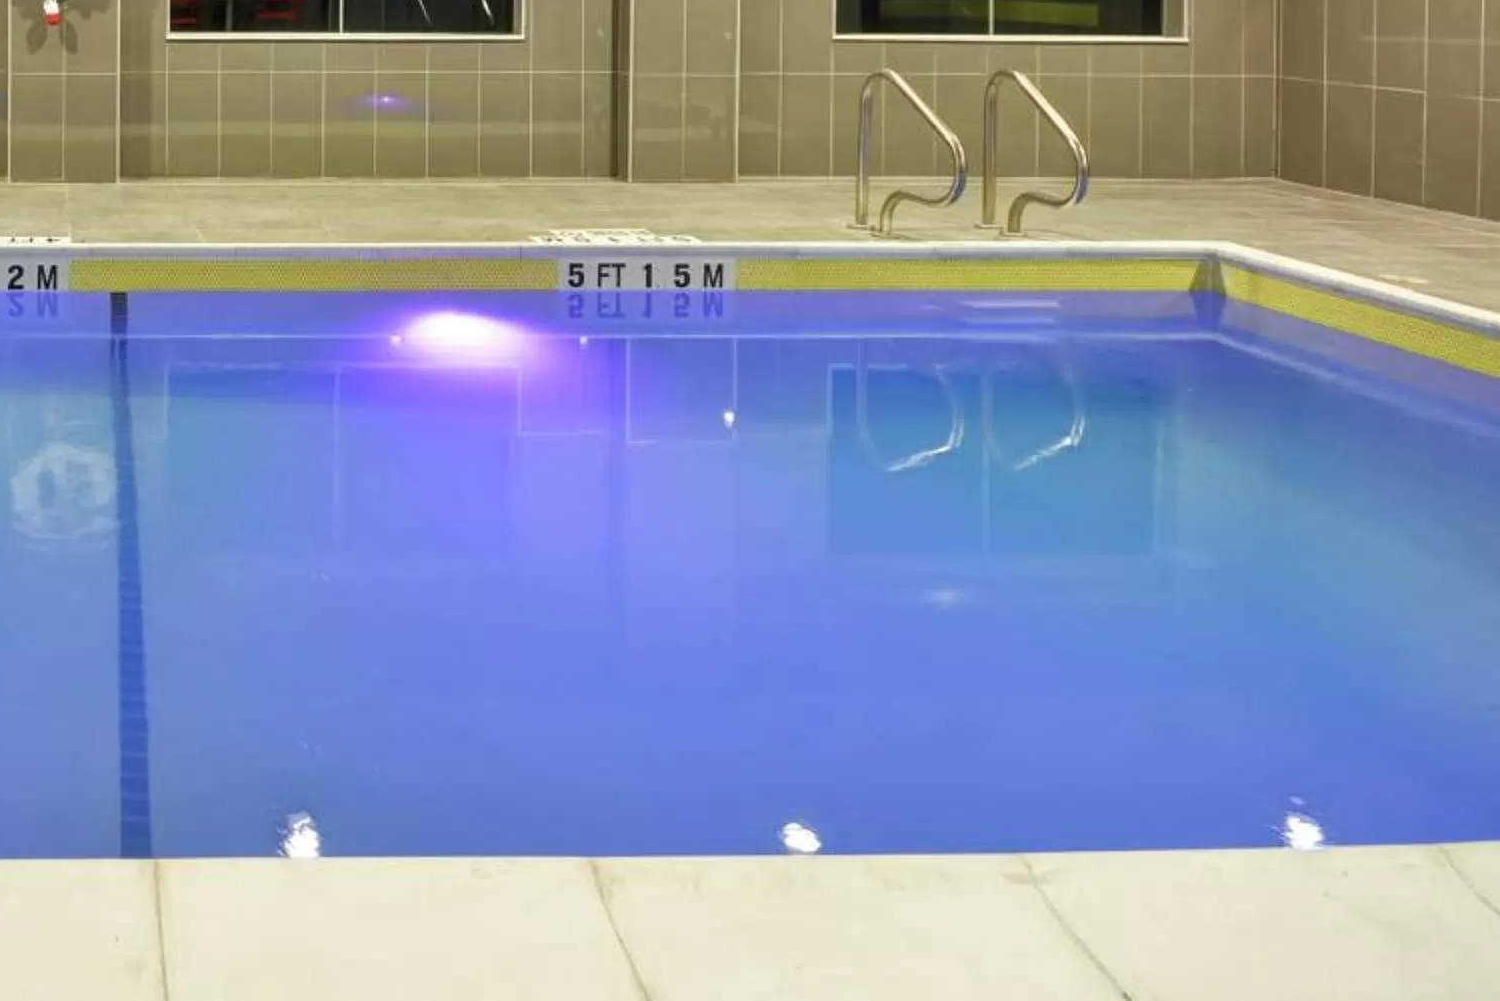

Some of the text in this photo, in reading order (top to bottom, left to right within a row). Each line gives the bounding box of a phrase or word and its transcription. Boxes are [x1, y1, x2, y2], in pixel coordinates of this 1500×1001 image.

[37, 264, 58, 290] M
[567, 262, 585, 288] 5
[597, 263, 626, 288] FT
[703, 263, 724, 288] M
